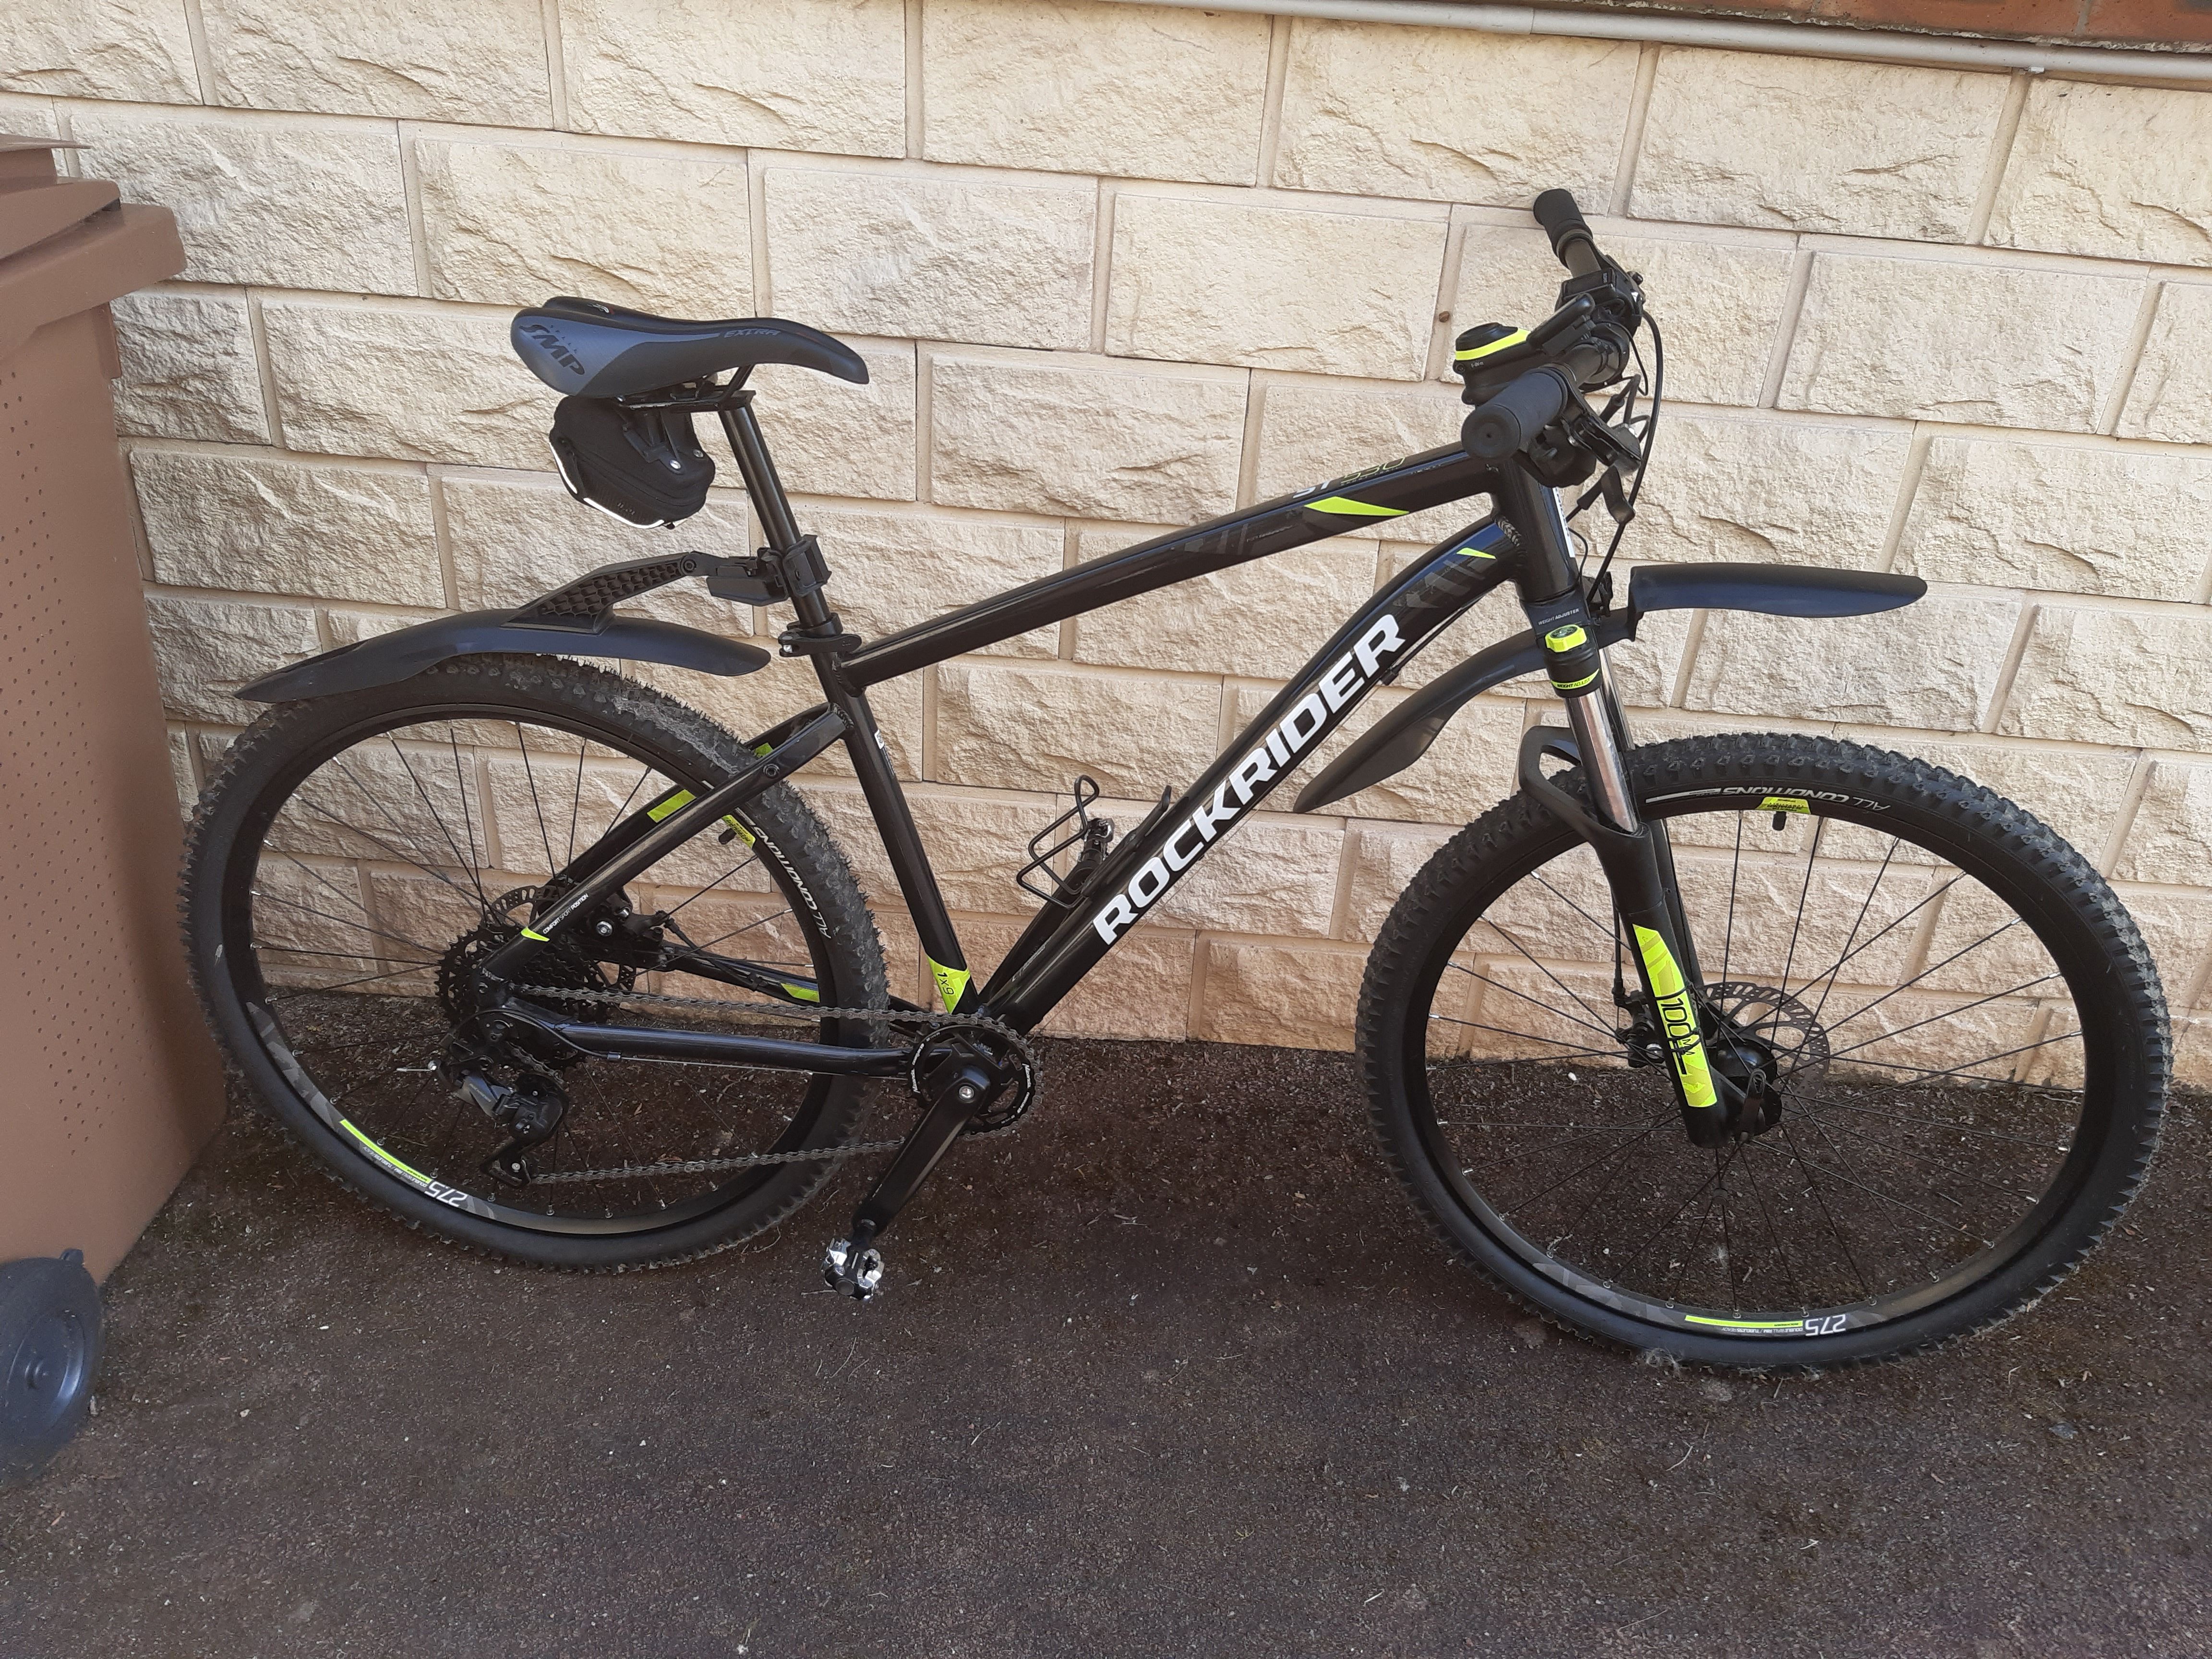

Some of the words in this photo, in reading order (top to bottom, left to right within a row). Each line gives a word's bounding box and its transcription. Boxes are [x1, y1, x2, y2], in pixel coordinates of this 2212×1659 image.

[723, 328, 781, 338] EXTRA
[518, 324, 585, 375] SMP
[1340, 457, 1406, 484] 530
[1538, 616, 1555, 625] WEIGHT
[1555, 608, 1579, 620] ADJUSTER
[1574, 678, 1590, 686] ADJUST
[1092, 613, 1407, 946] ROCKRIDER
[1720, 786, 1851, 804] CONDITIONS
[1852, 796, 1891, 811] ALL
[542, 917, 561, 934] COMFORT
[559, 907, 572, 920] SPORT
[570, 893, 589, 910] POSITION
[813, 912, 832, 939] ALL
[937, 972, 955, 996] 1x9
[1804, 1313, 1846, 1337] 27.5
